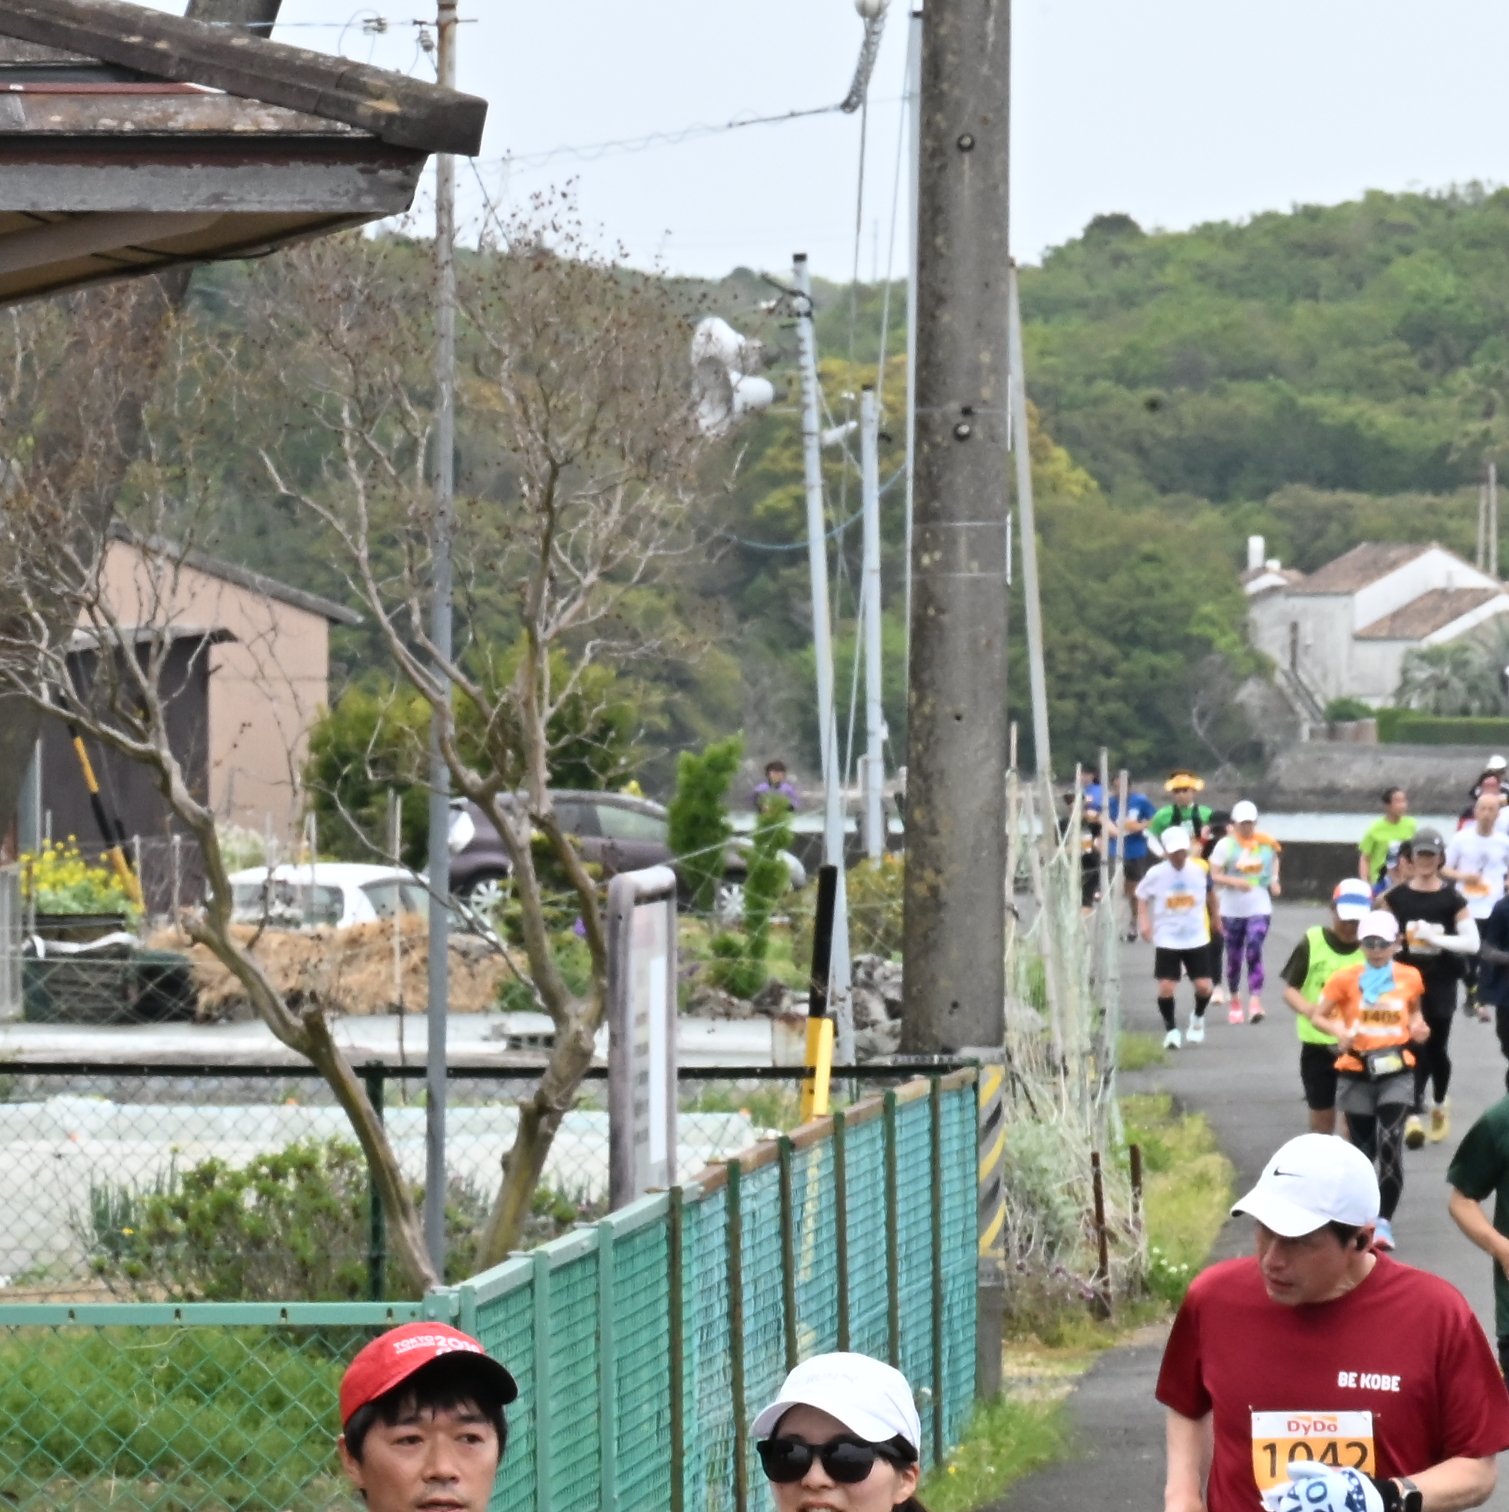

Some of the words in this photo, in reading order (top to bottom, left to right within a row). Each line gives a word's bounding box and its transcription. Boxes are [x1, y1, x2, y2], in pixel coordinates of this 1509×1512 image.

[393, 1335, 434, 1350] TOKYO
[1338, 1371, 1358, 1388] BE
[1360, 1373, 1401, 1391] KOBE
[1287, 1420, 1338, 1435] DyDo
[1262, 1441, 1373, 1479] 1042
